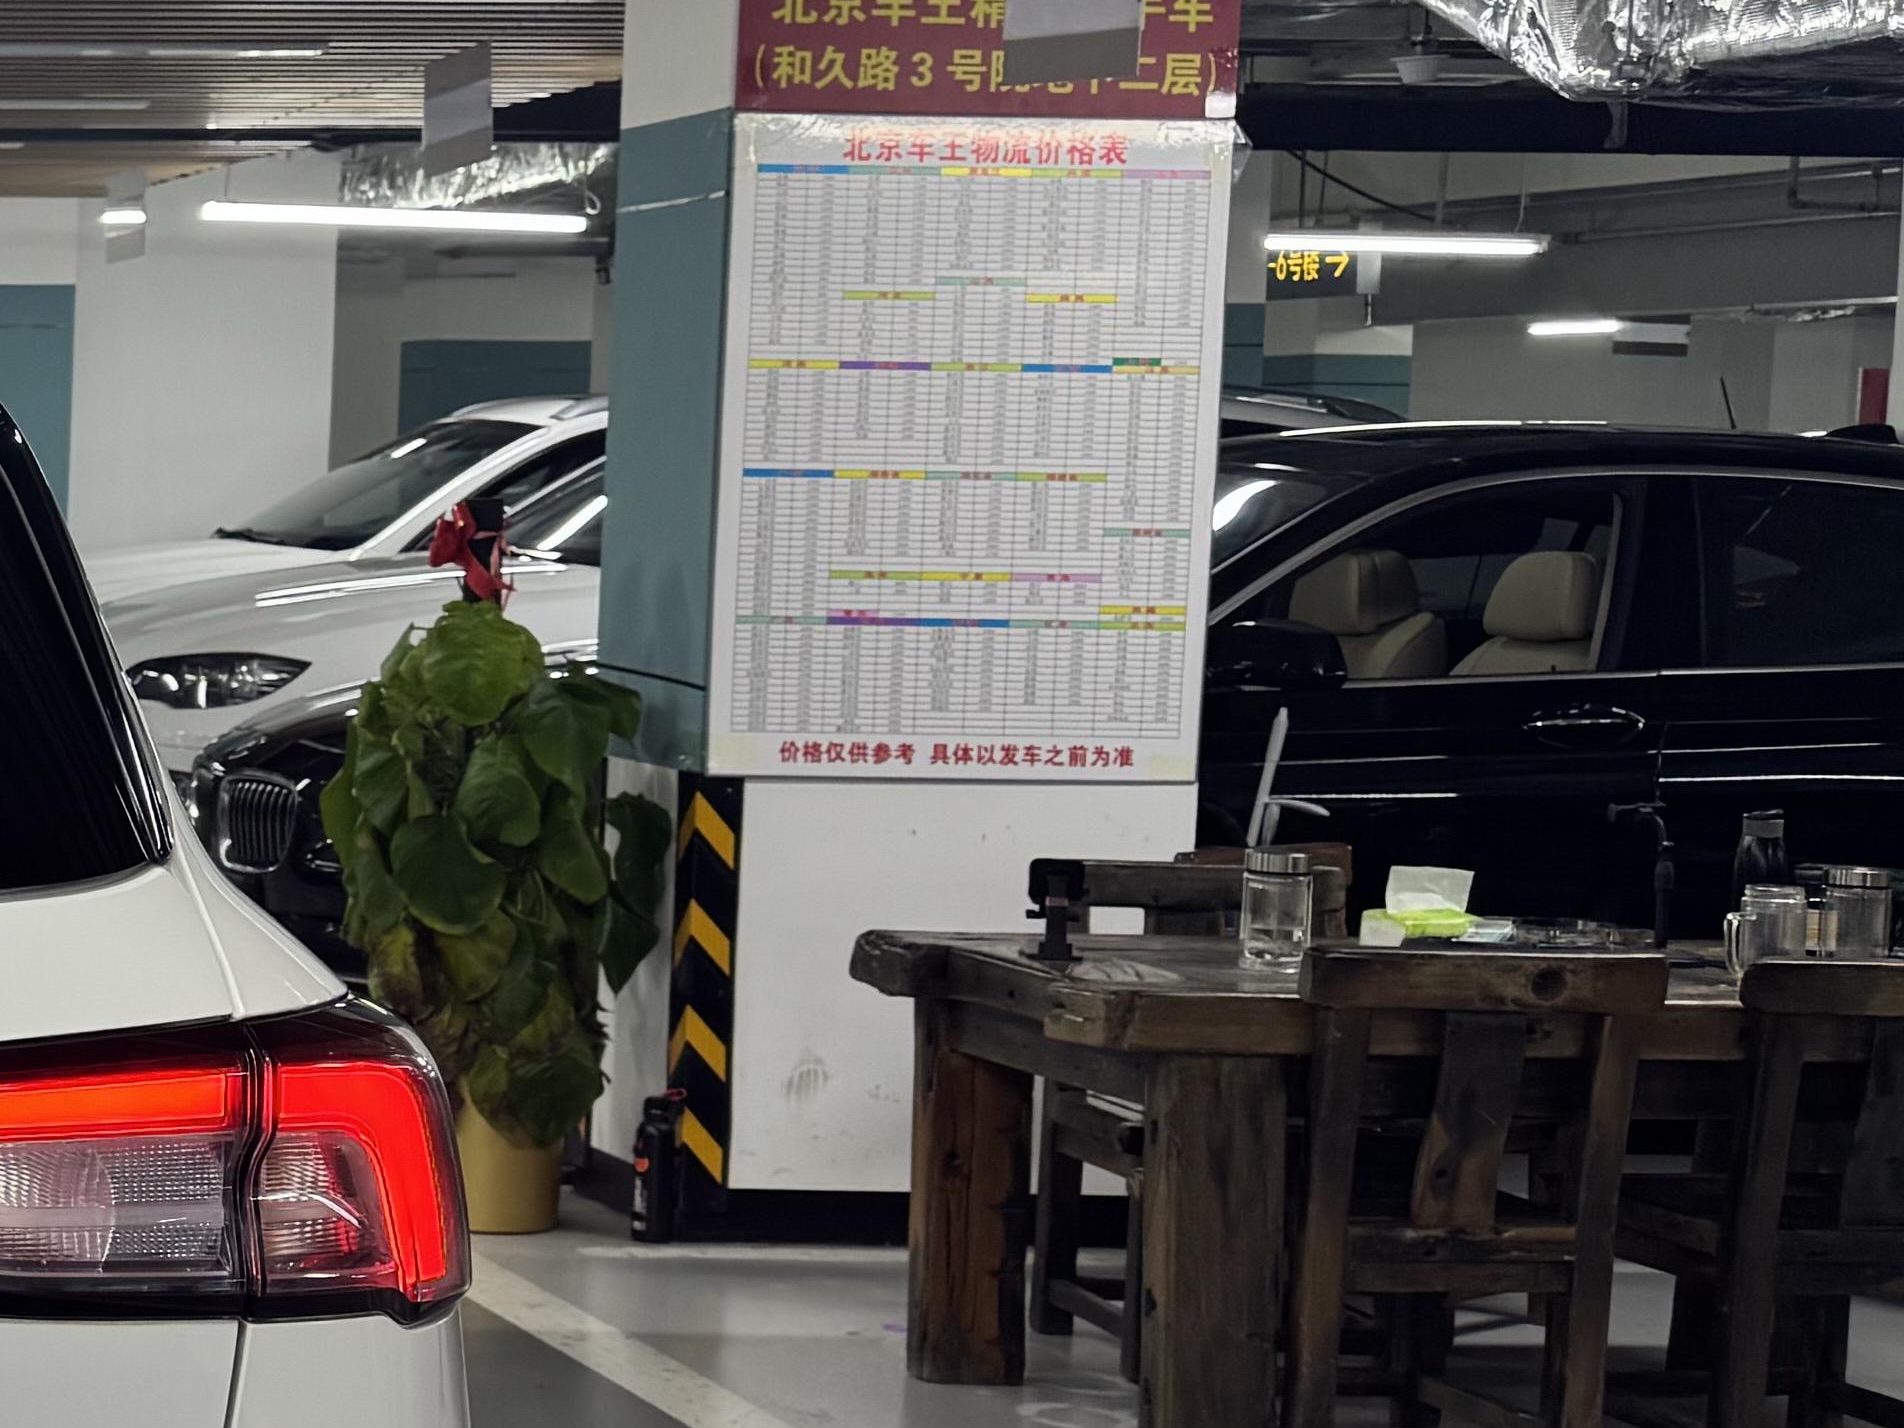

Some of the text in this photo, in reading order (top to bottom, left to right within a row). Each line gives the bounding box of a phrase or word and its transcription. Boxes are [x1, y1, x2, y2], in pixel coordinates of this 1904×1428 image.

[779, 740, 1136, 769] 价格仅供参考 具体以发车之前为准
